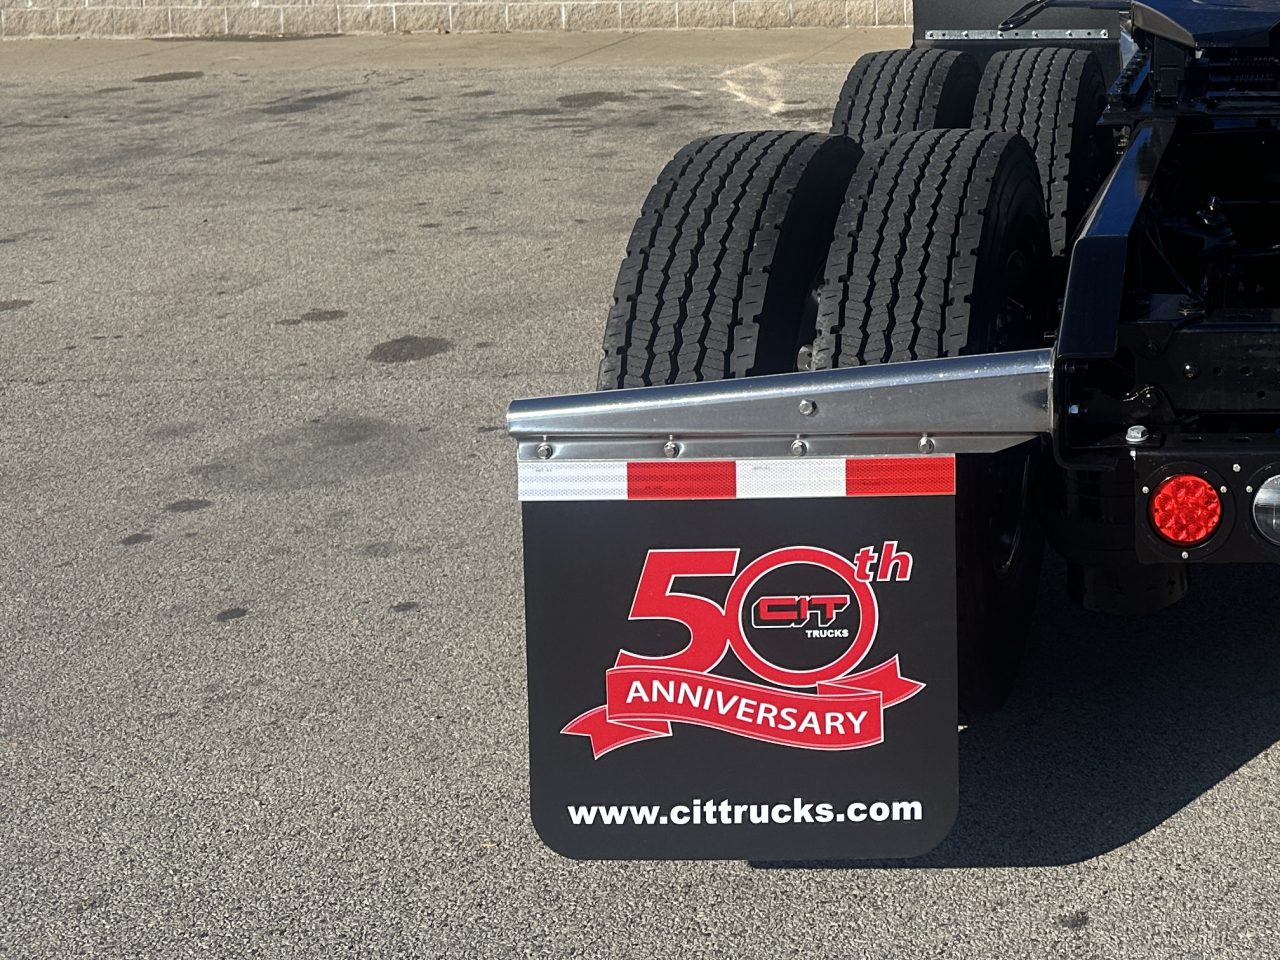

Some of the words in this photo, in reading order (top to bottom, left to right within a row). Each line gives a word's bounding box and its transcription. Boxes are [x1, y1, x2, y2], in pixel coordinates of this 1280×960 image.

[751, 594, 851, 629] CIT
[805, 629, 849, 638] TRUCKS
[625, 679, 869, 735] ANNIVERSARY
[567, 797, 923, 825] www.cittrucks.com
